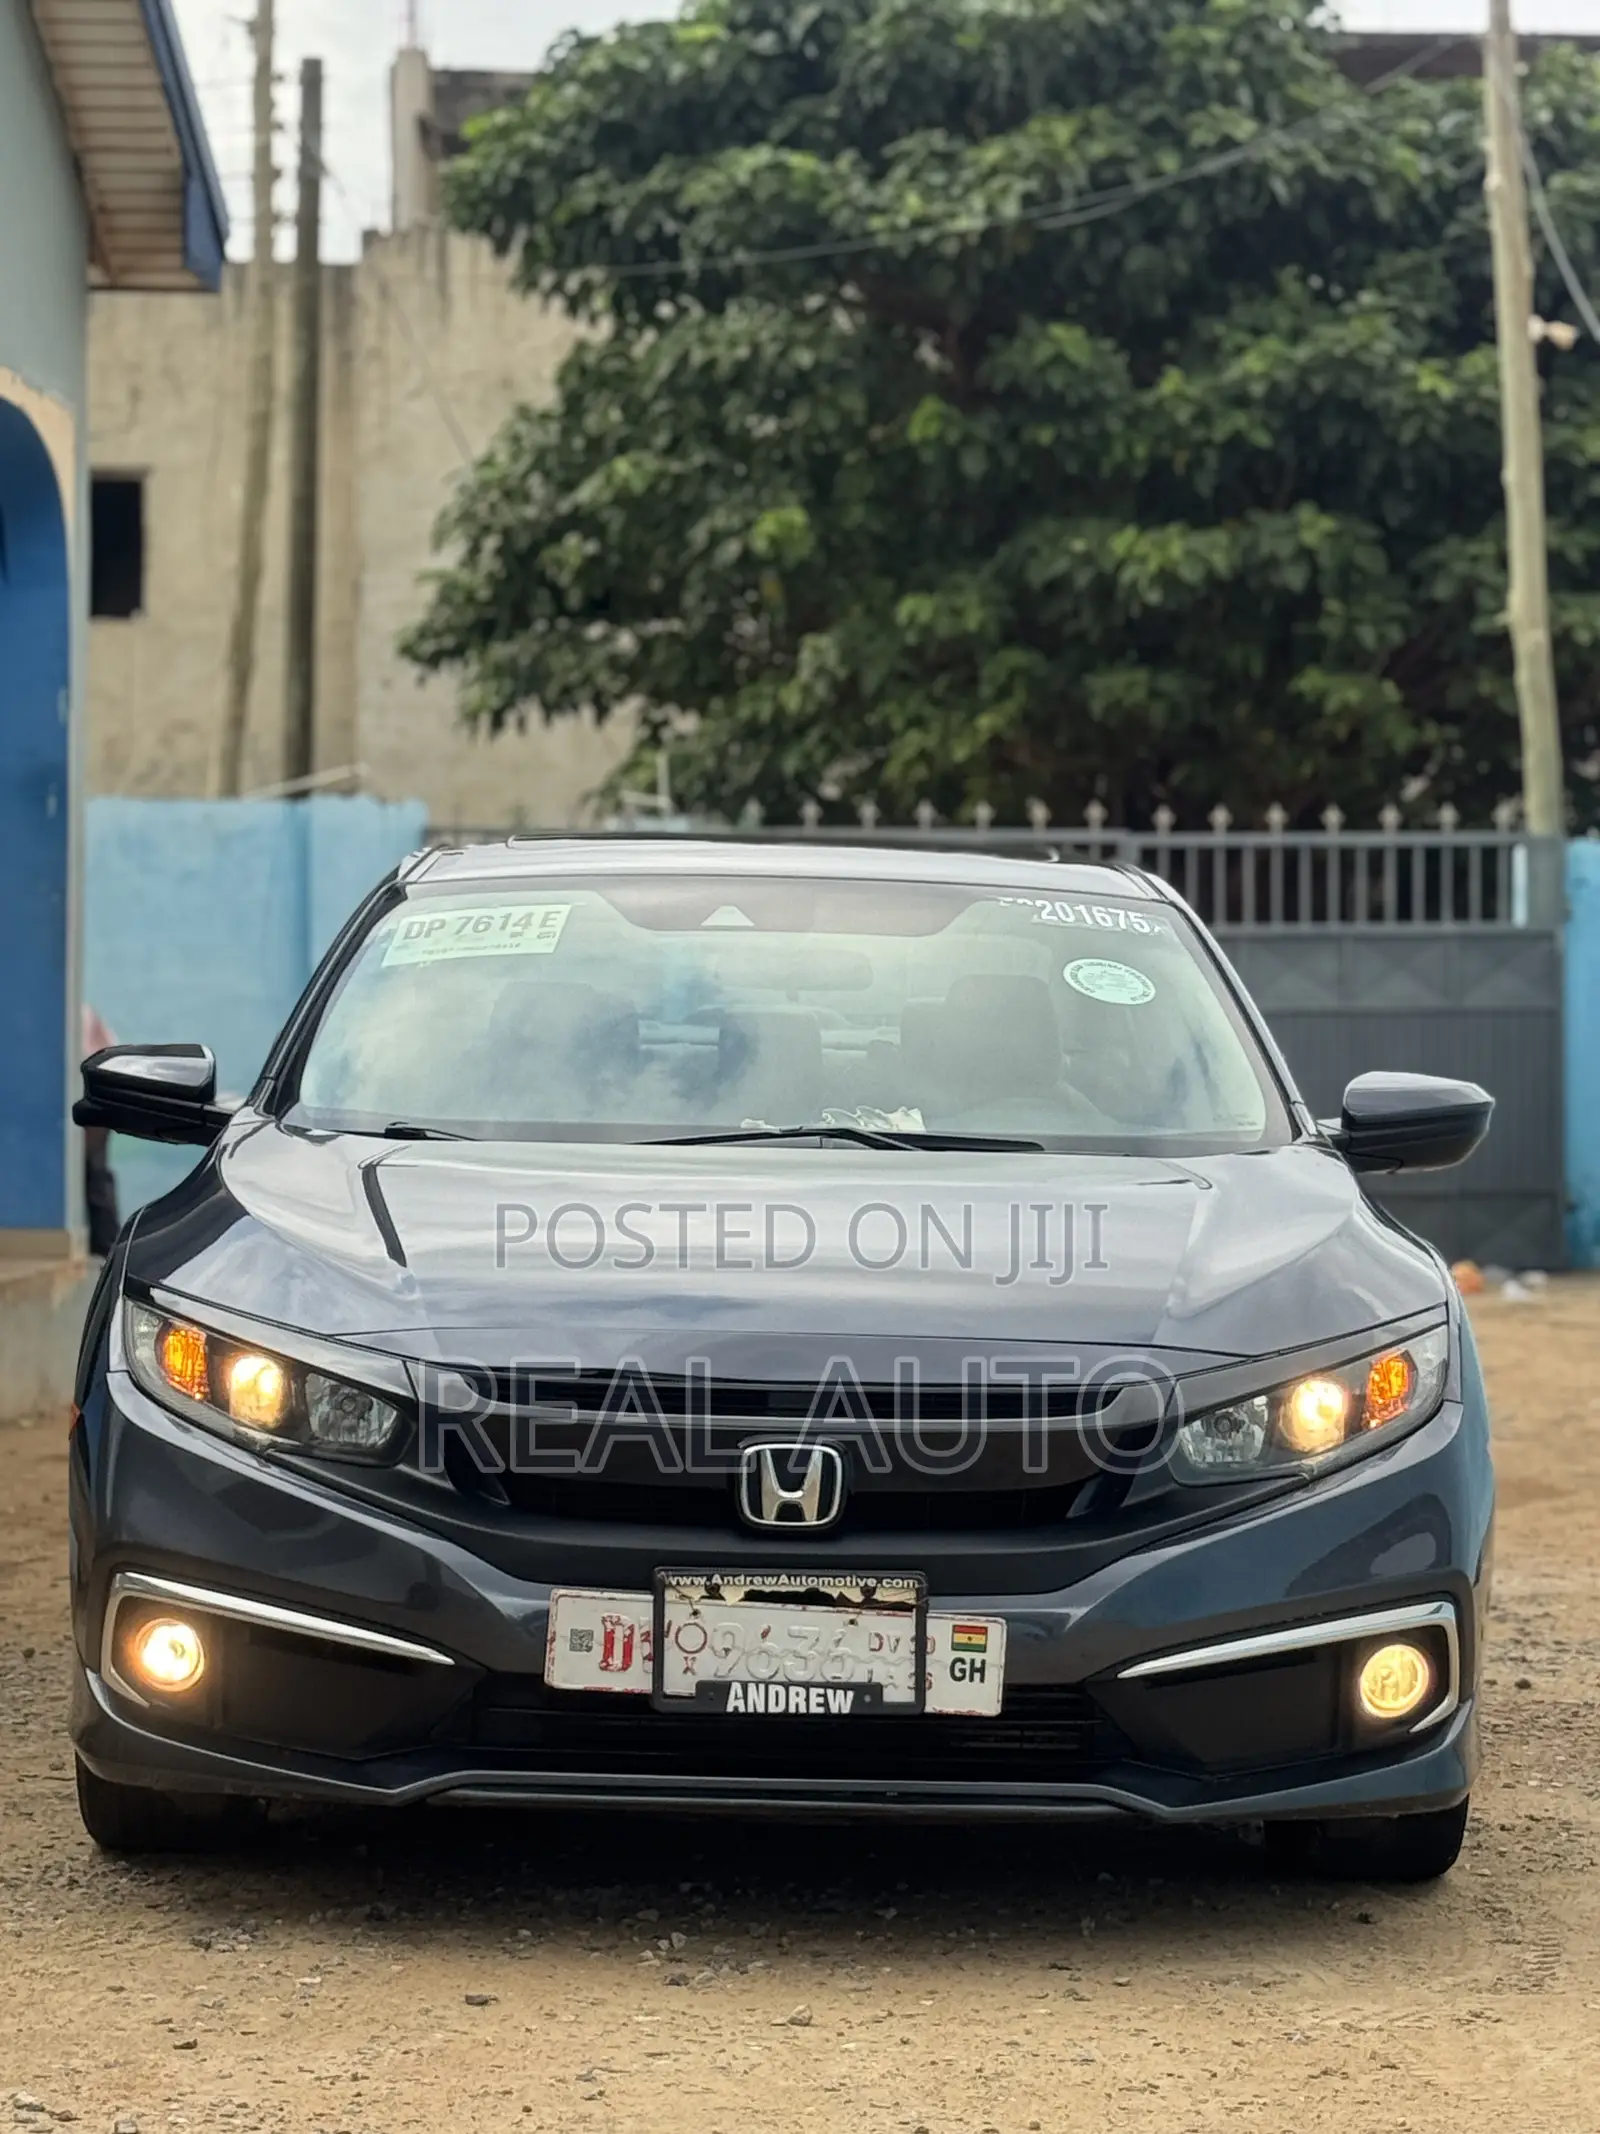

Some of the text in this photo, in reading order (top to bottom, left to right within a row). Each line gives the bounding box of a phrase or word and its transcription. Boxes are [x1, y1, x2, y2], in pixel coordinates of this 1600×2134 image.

[403, 910, 562, 941] DP 7614 E
[665, 1572, 920, 1588] www.AndrewAutomotive.com
[948, 1657, 987, 1684] GH
[725, 1682, 857, 1715] ANDREW
